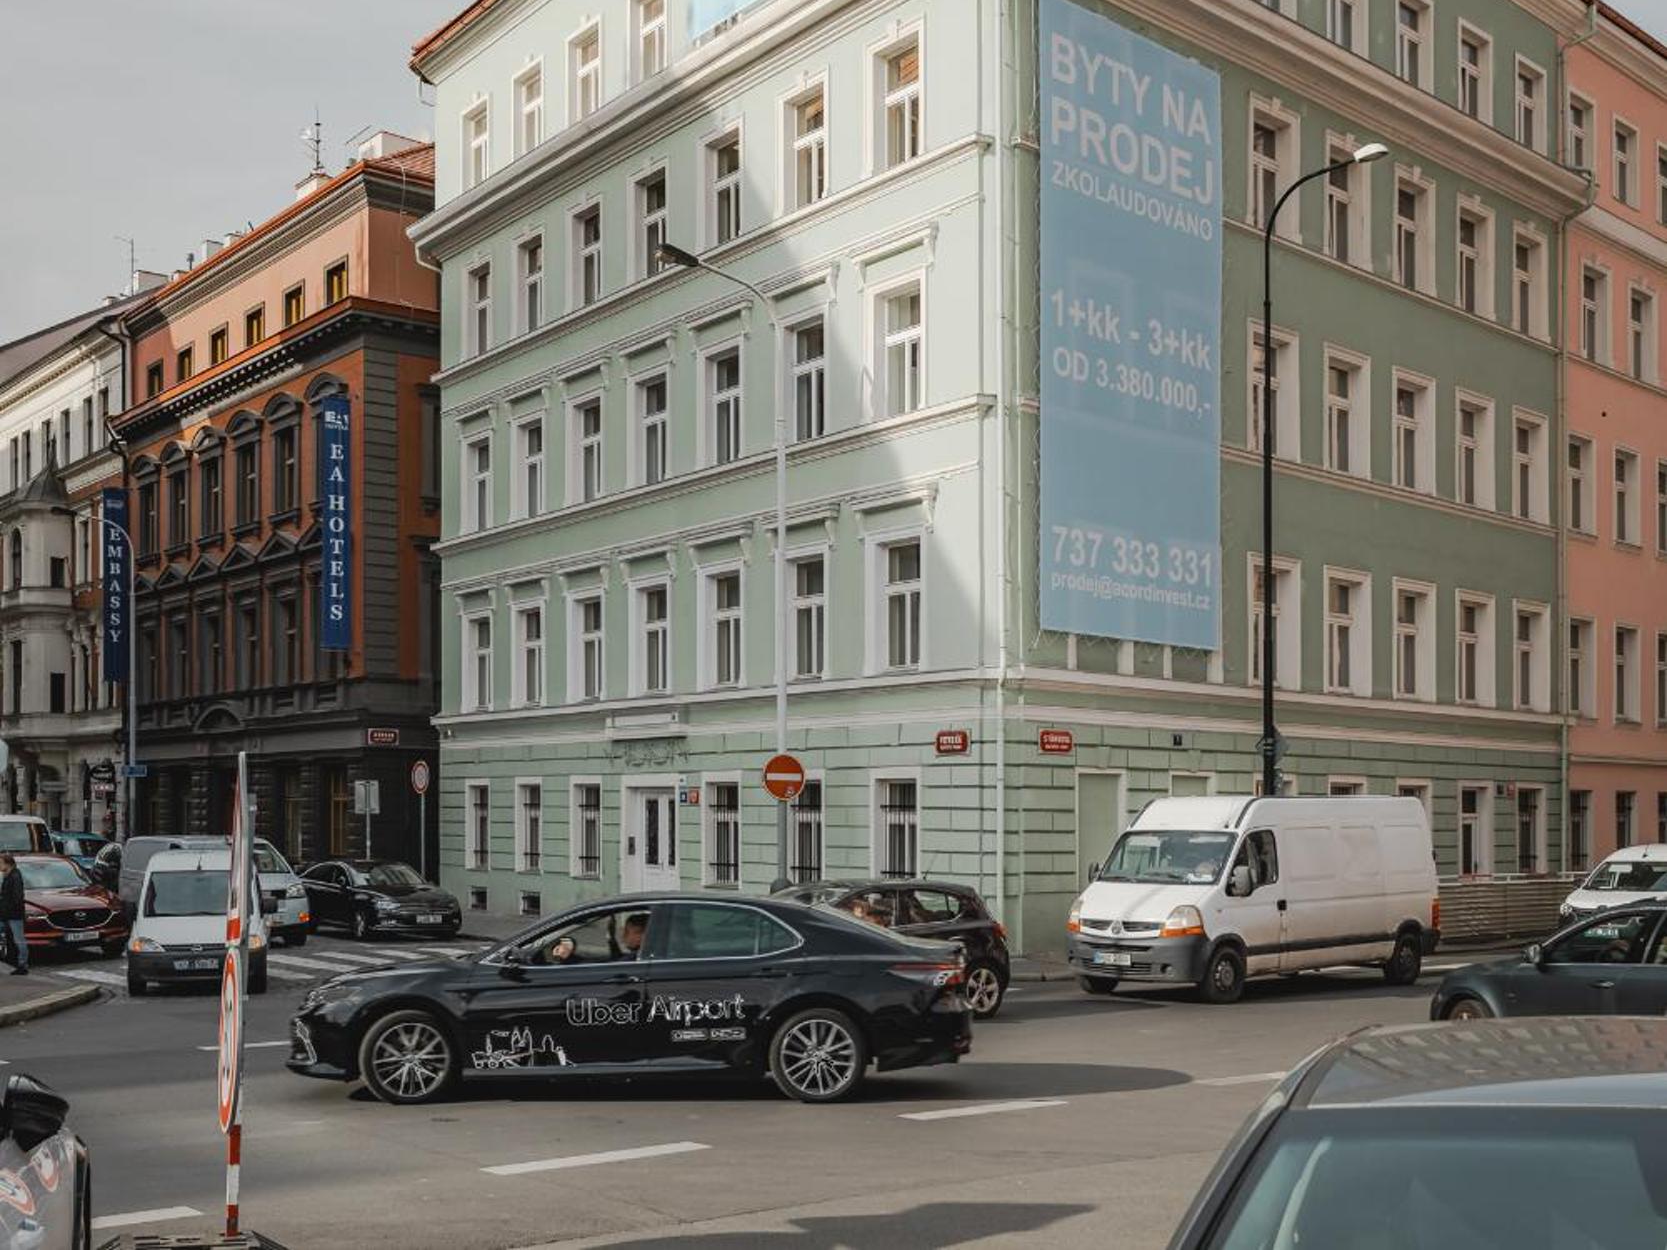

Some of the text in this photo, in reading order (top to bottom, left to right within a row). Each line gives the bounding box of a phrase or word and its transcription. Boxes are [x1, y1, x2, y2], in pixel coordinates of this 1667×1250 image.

[1051, 31, 1212, 145] BYTY NA
[1051, 95, 1214, 205] PRODEJ
[1051, 160, 1213, 241] ZKOLAUDOVÁNO
[1051, 288, 1121, 344] 1+kk
[1148, 318, 1212, 370] 3+kk
[1053, 347, 1211, 420] OD 3.380.000,-
[328, 443, 345, 482] EA
[107, 528, 122, 642] EMBASSY
[328, 494, 345, 620] HOTELS
[1051, 525, 1212, 587] 737 333 331
[566, 992, 747, 1026] Uber Airport
